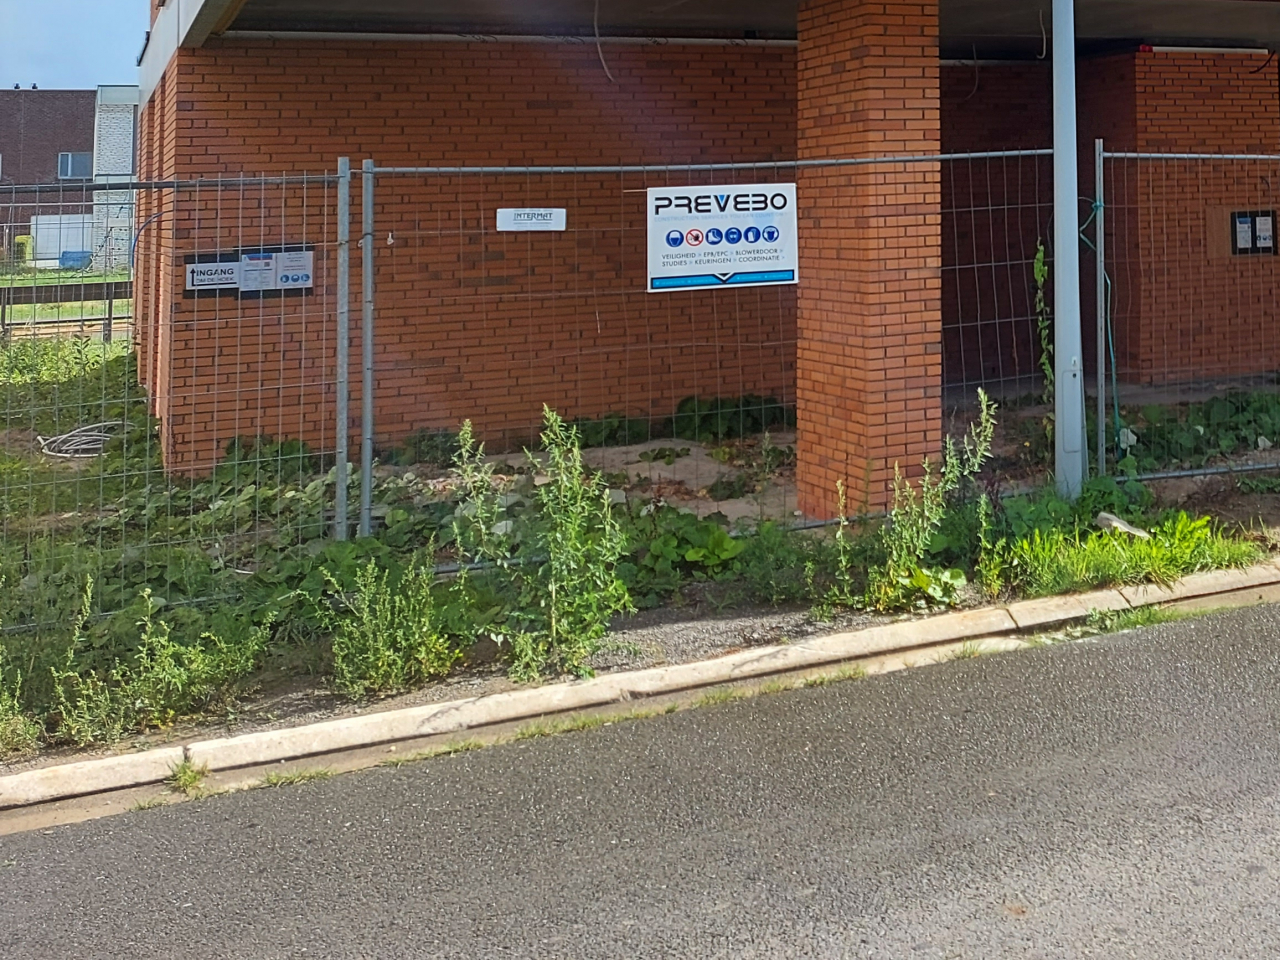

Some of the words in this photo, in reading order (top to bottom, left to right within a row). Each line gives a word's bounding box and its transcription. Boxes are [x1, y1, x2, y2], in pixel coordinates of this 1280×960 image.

[654, 193, 787, 215] PREVEBO
[513, 212, 553, 221] INTERMAT
[662, 252, 696, 260] VEILIGHEID
[703, 250, 729, 258] EPB/EPC
[735, 248, 778, 256] BLOWERDOOR
[738, 255, 780, 263] COORDINATIE
[196, 268, 234, 277] INGANG
